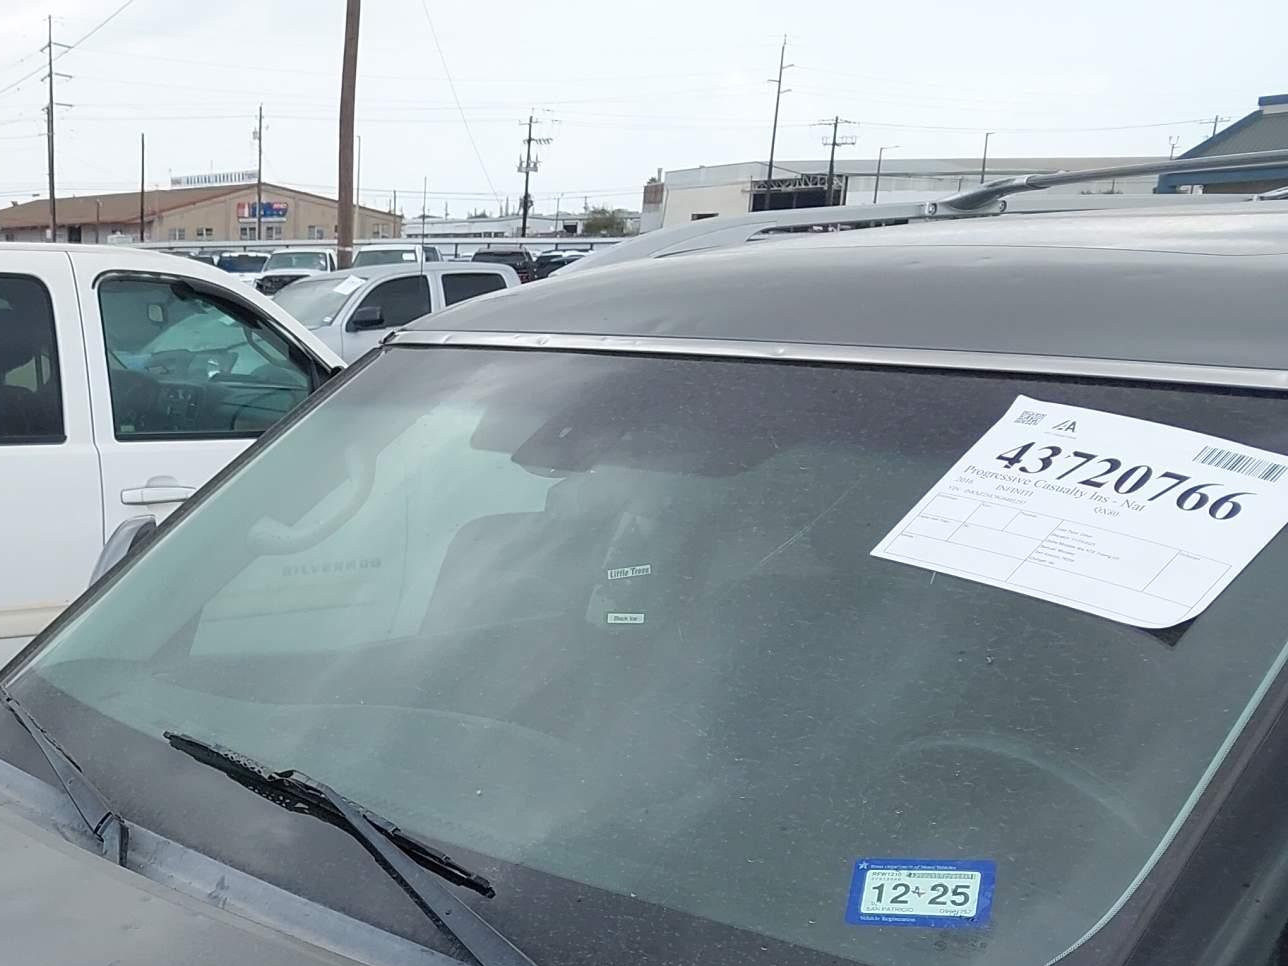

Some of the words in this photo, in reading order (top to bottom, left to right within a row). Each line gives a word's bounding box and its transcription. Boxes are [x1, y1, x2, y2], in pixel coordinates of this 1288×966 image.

[963, 464, 1032, 486] Progressive
[1033, 479, 1087, 498] Casualty
[1089, 490, 1109, 504] Ins
[995, 484, 1034, 498] INFINITI
[996, 441, 1257, 521] 43720766
[609, 569, 629, 580] Little
[872, 882, 911, 905] 12
[927, 883, 971, 907] 25
